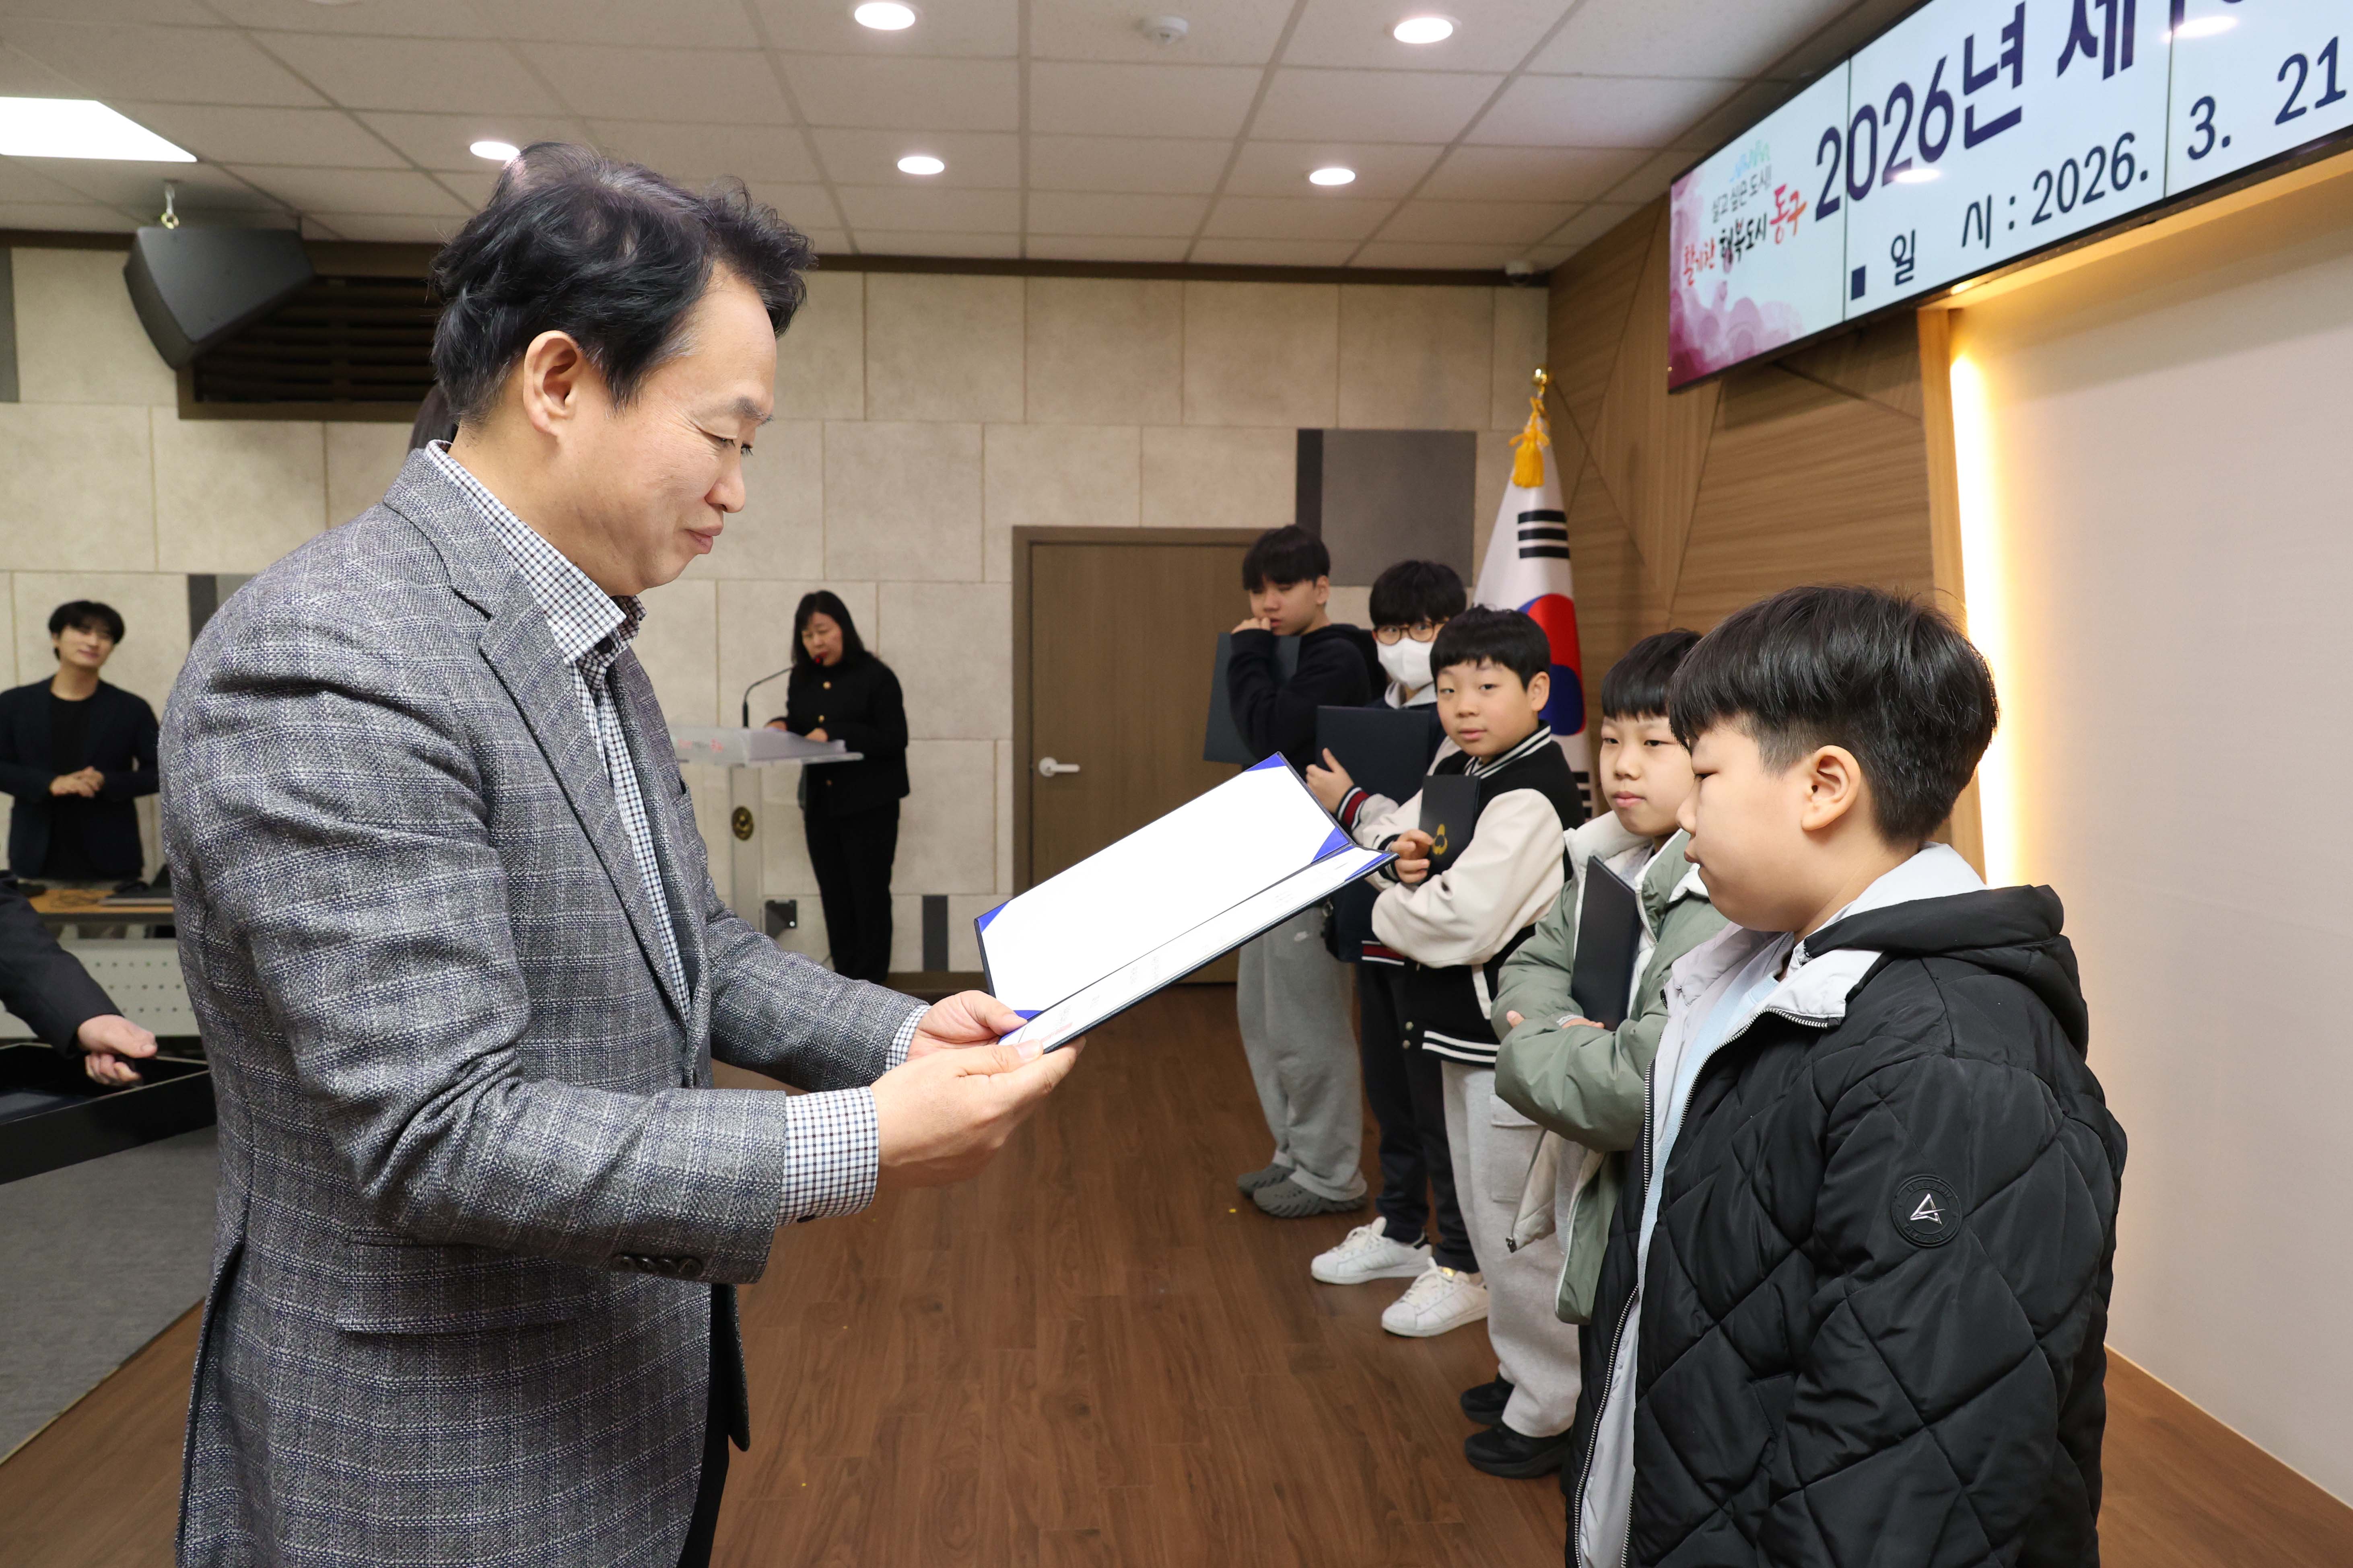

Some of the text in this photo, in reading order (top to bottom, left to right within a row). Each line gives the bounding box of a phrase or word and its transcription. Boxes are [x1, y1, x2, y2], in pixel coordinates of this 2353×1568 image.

[1770, 183, 1807, 245] 동구
[1815, 1, 2025, 222] 2026년
[1890, 229, 1916, 286] 일
[2031, 132, 2148, 226] 2026.
[2187, 95, 2231, 161] 3.
[2274, 36, 2347, 126] 21
